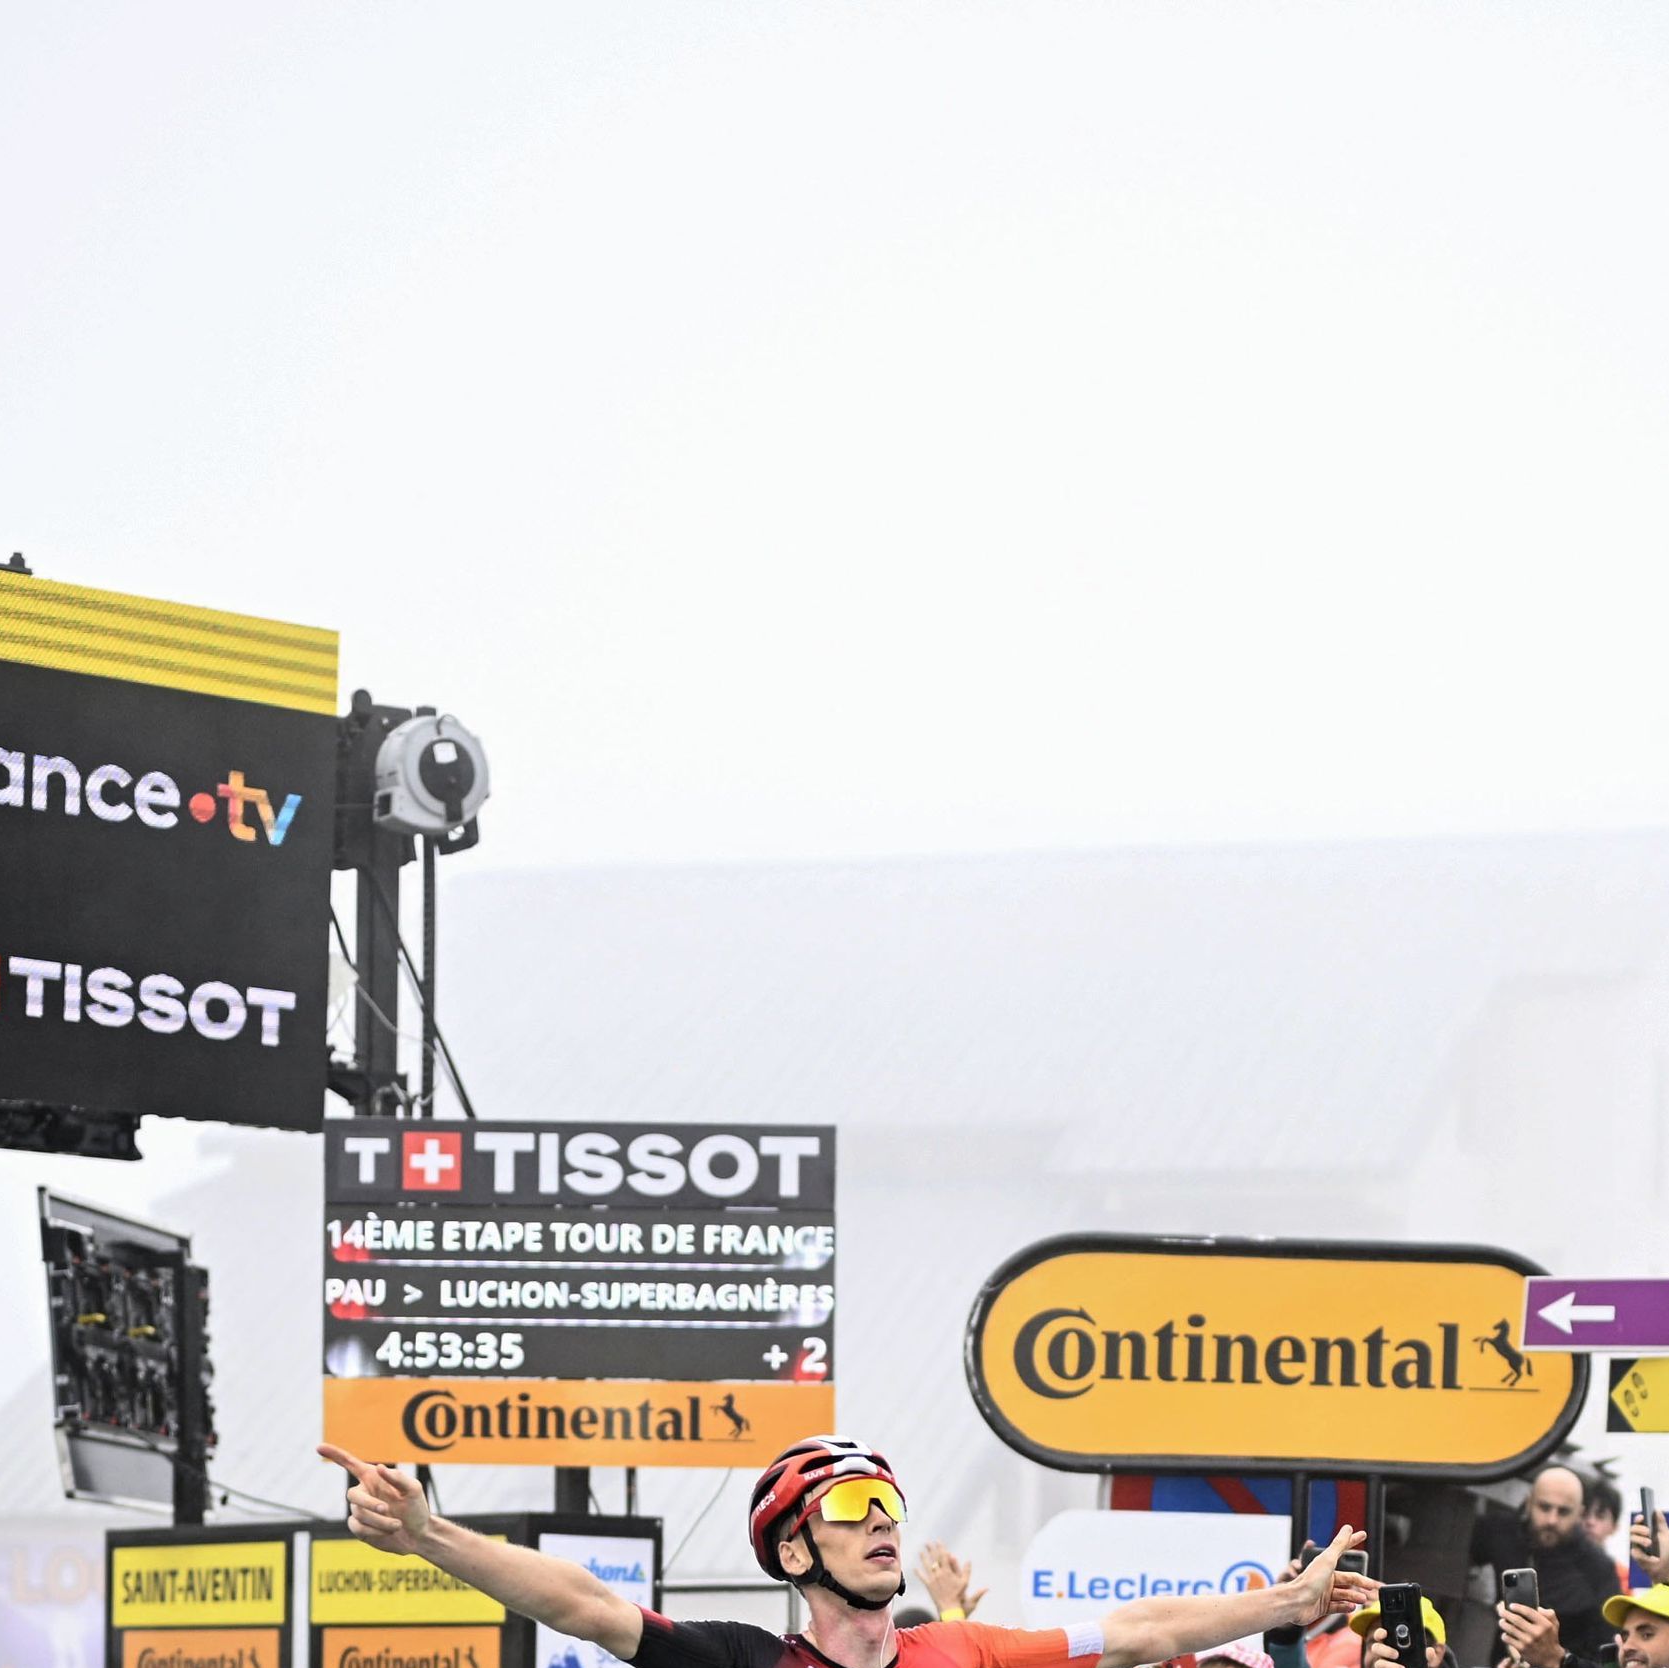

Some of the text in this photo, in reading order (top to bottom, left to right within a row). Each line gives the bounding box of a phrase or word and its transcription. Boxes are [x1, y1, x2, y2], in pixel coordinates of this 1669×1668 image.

[9, 957, 296, 1047] TISSOT
[474, 1133, 820, 1198] TISSOT
[327, 1212, 835, 1257] 14ÈME ETAPE TOUR DE FRANCE
[326, 1279, 387, 1306] PAU
[440, 1276, 835, 1312] LUCHON-SUPERBAGNÈRES
[376, 1332, 525, 1370] 4:53:35
[801, 1338, 828, 1374] 2
[1012, 1307, 1463, 1400] Continental
[402, 1390, 703, 1451] Continental
[122, 1566, 274, 1604] SAINT-AVENTIN
